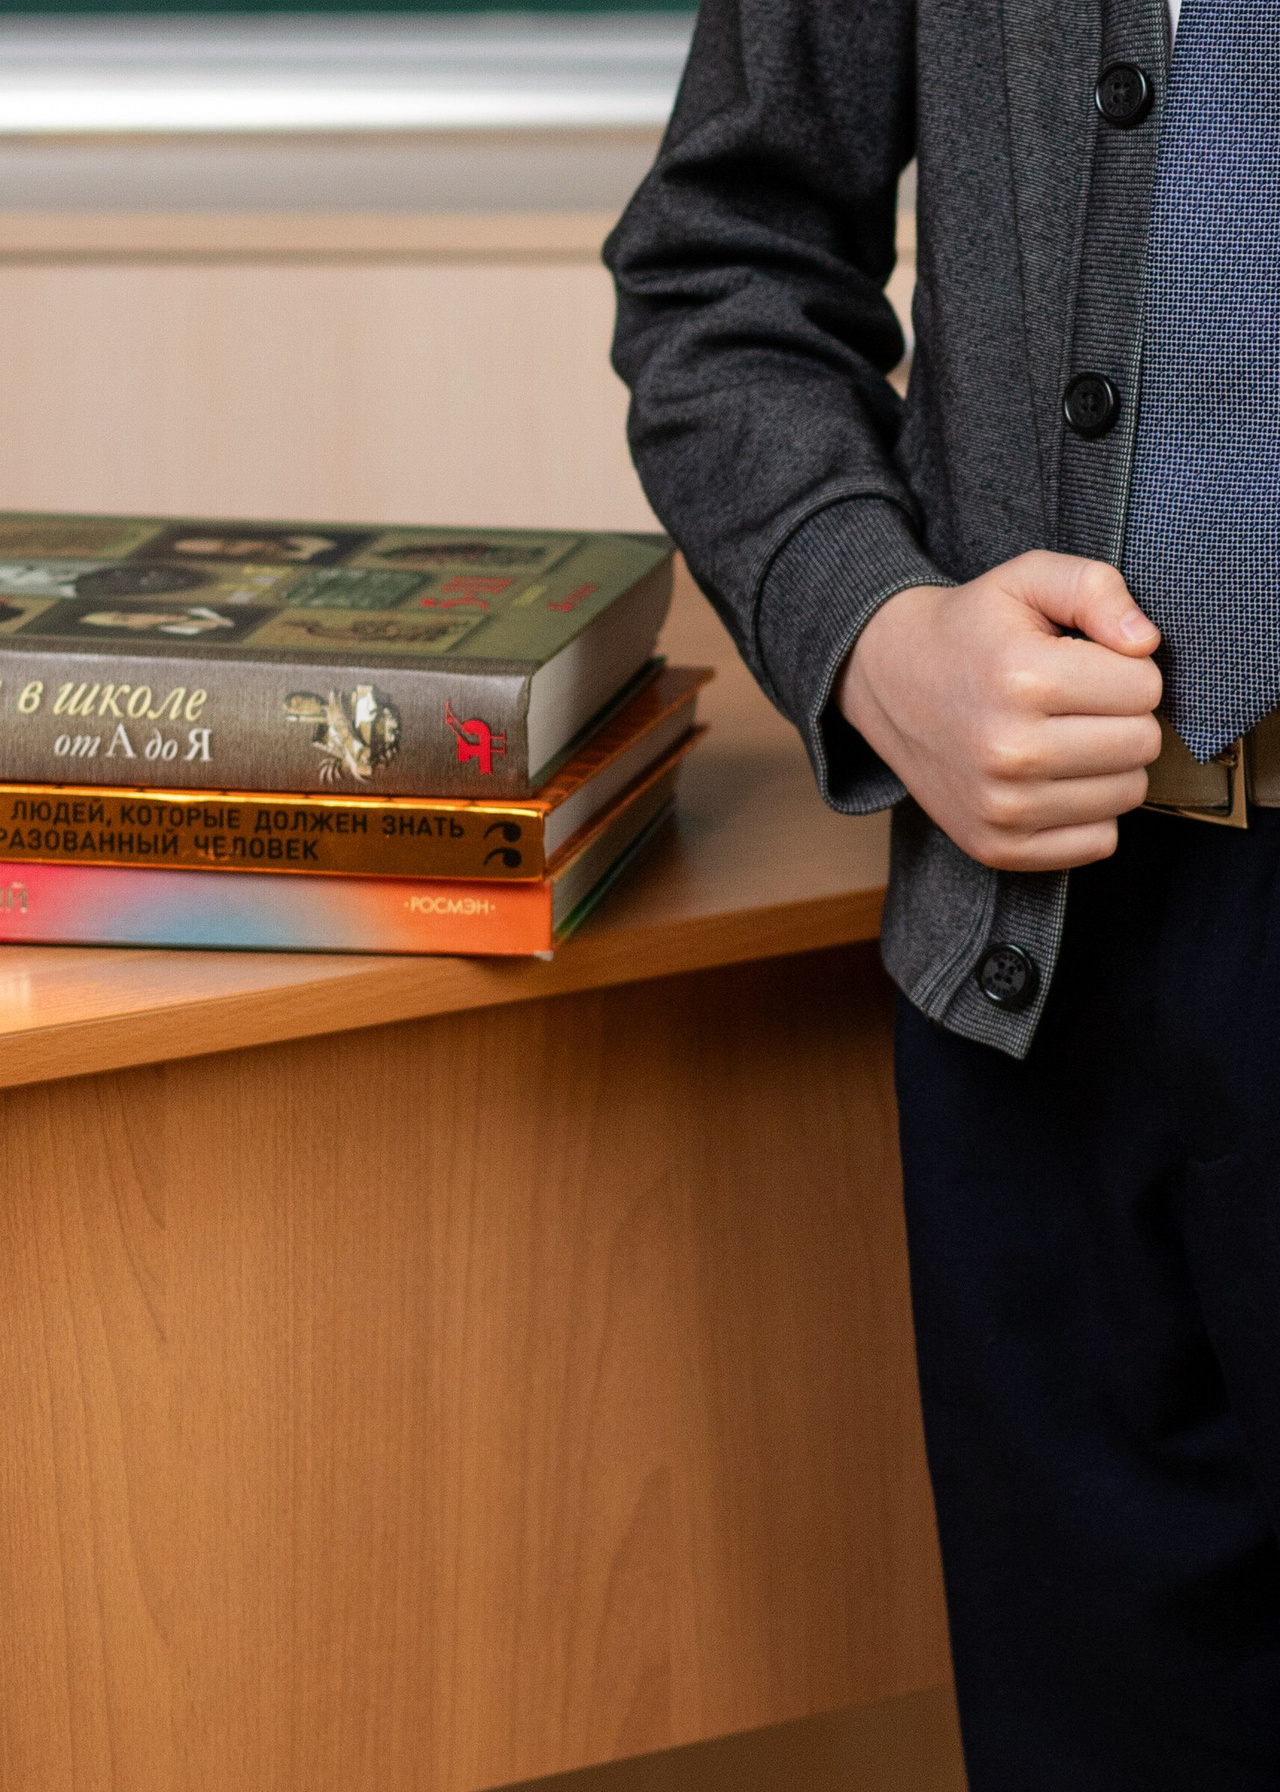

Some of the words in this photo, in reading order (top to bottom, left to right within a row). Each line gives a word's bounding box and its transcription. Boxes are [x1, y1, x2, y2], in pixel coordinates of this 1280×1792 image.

[18, 680, 44, 715] в
[53, 681, 207, 722] школе
[54, 733, 101, 758] от
[106, 723, 137, 759] А
[145, 728, 179, 762] до
[186, 727, 213, 763] Я
[120, 805, 241, 830] КОТОРЫЕ
[254, 810, 368, 835] ДОЛЖЕН
[382, 815, 465, 839] ЗНАТЬ
[194, 835, 319, 861] ЧЕЛОВЕК
